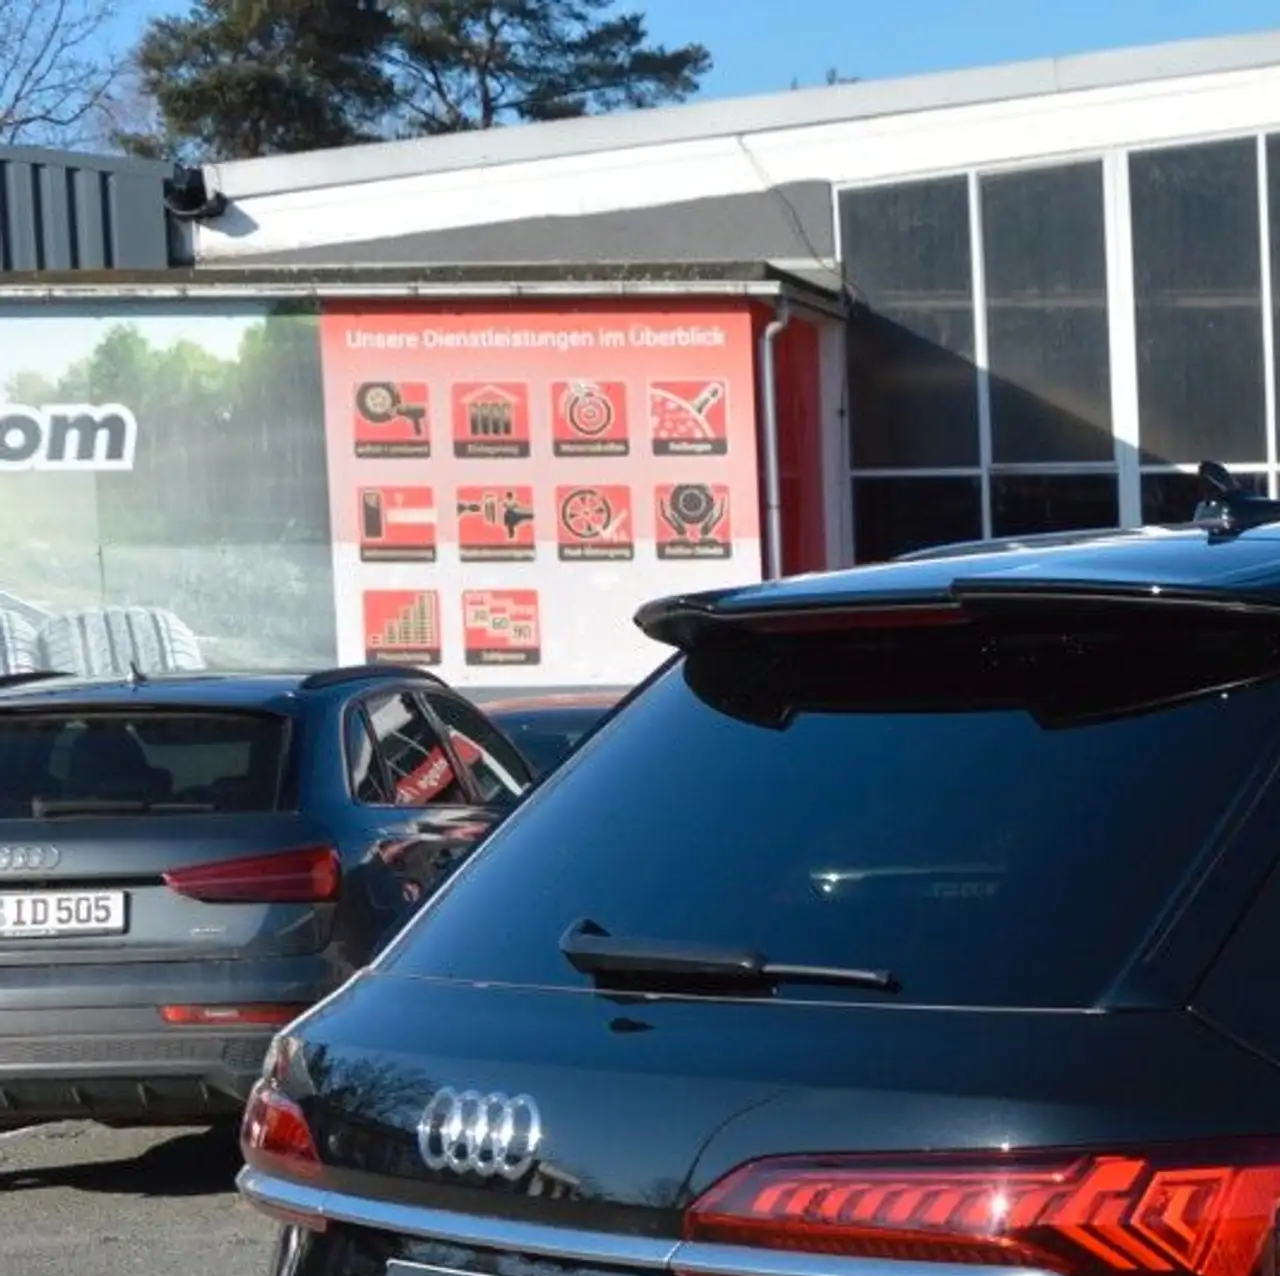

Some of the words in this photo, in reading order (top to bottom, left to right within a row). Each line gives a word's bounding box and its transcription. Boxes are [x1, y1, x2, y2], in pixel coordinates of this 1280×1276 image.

[345, 328, 419, 350] Unsere
[422, 325, 596, 353] Dienstleistungen
[598, 325, 627, 348] im
[628, 320, 727, 348] Überblick
[56, 895, 112, 924] 505
